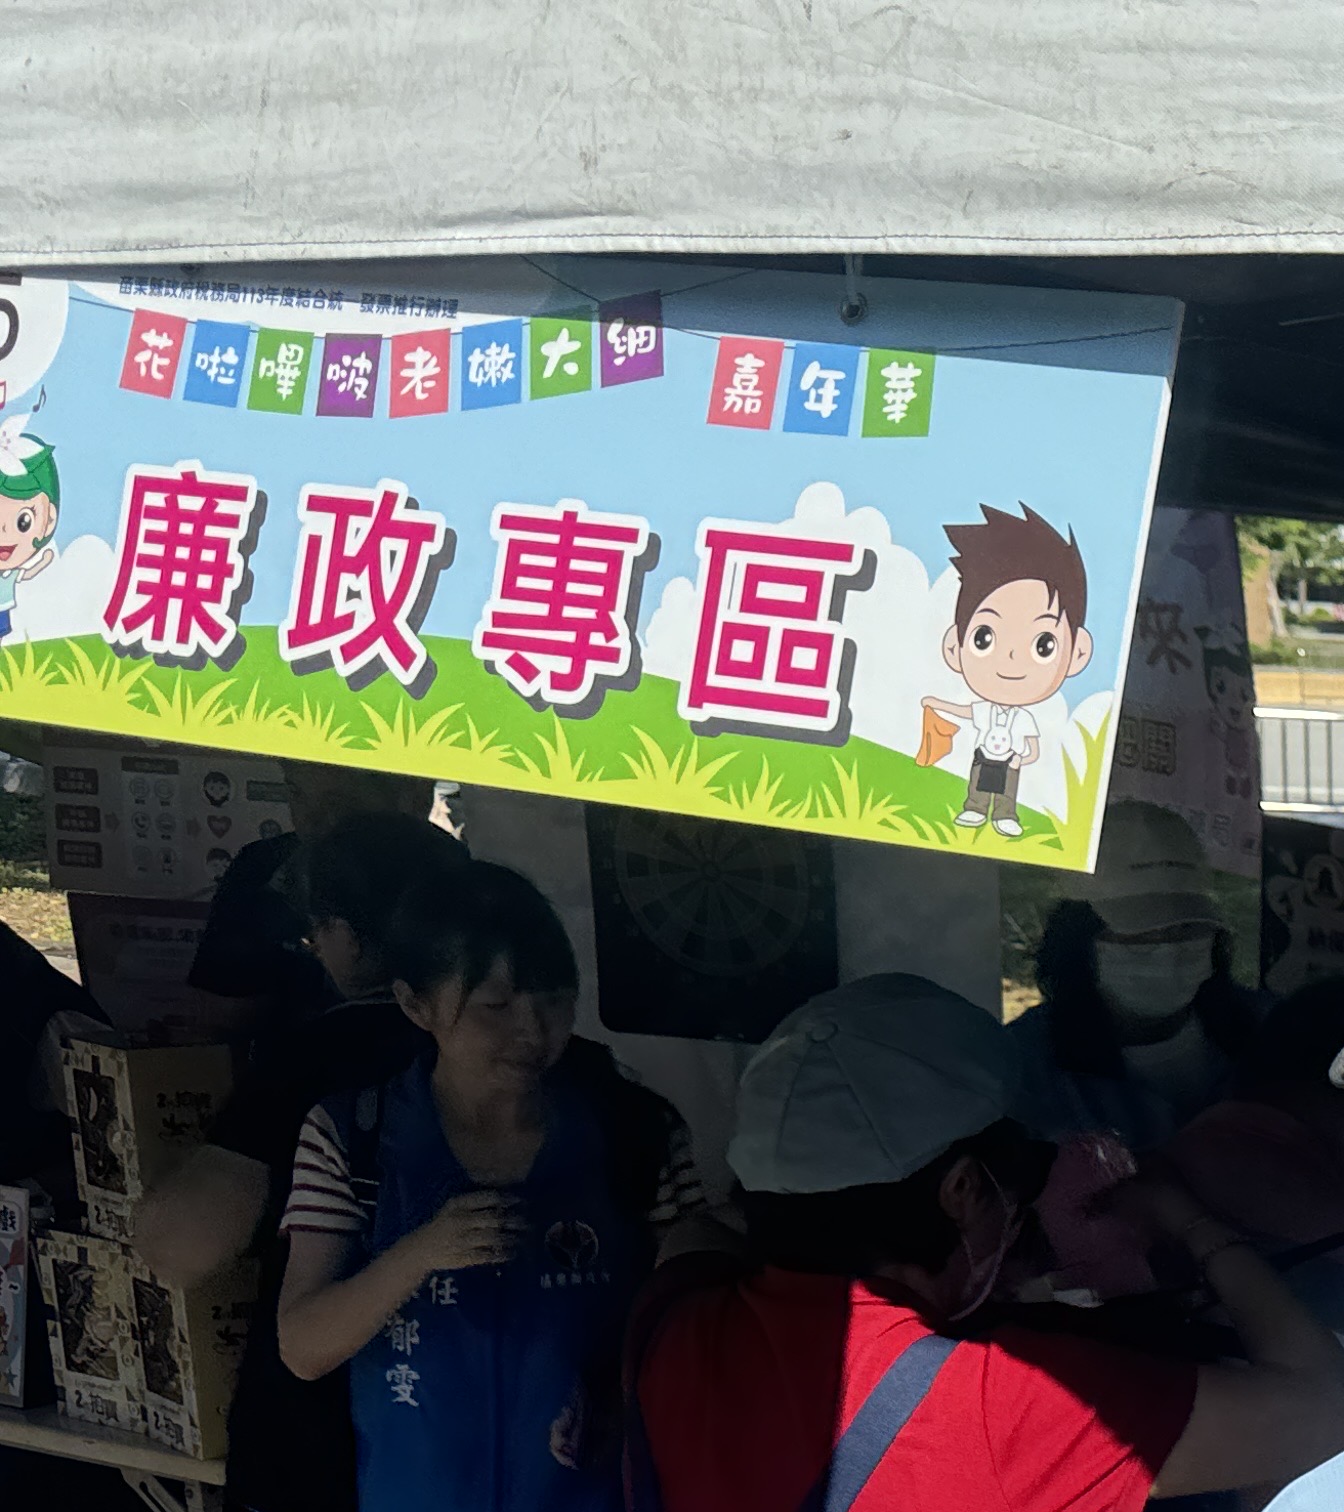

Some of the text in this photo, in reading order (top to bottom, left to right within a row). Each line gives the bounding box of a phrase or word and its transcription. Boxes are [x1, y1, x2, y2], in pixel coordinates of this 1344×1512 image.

[720, 350, 922, 426] 嘉年華
[100, 466, 868, 724] 廉政專區
